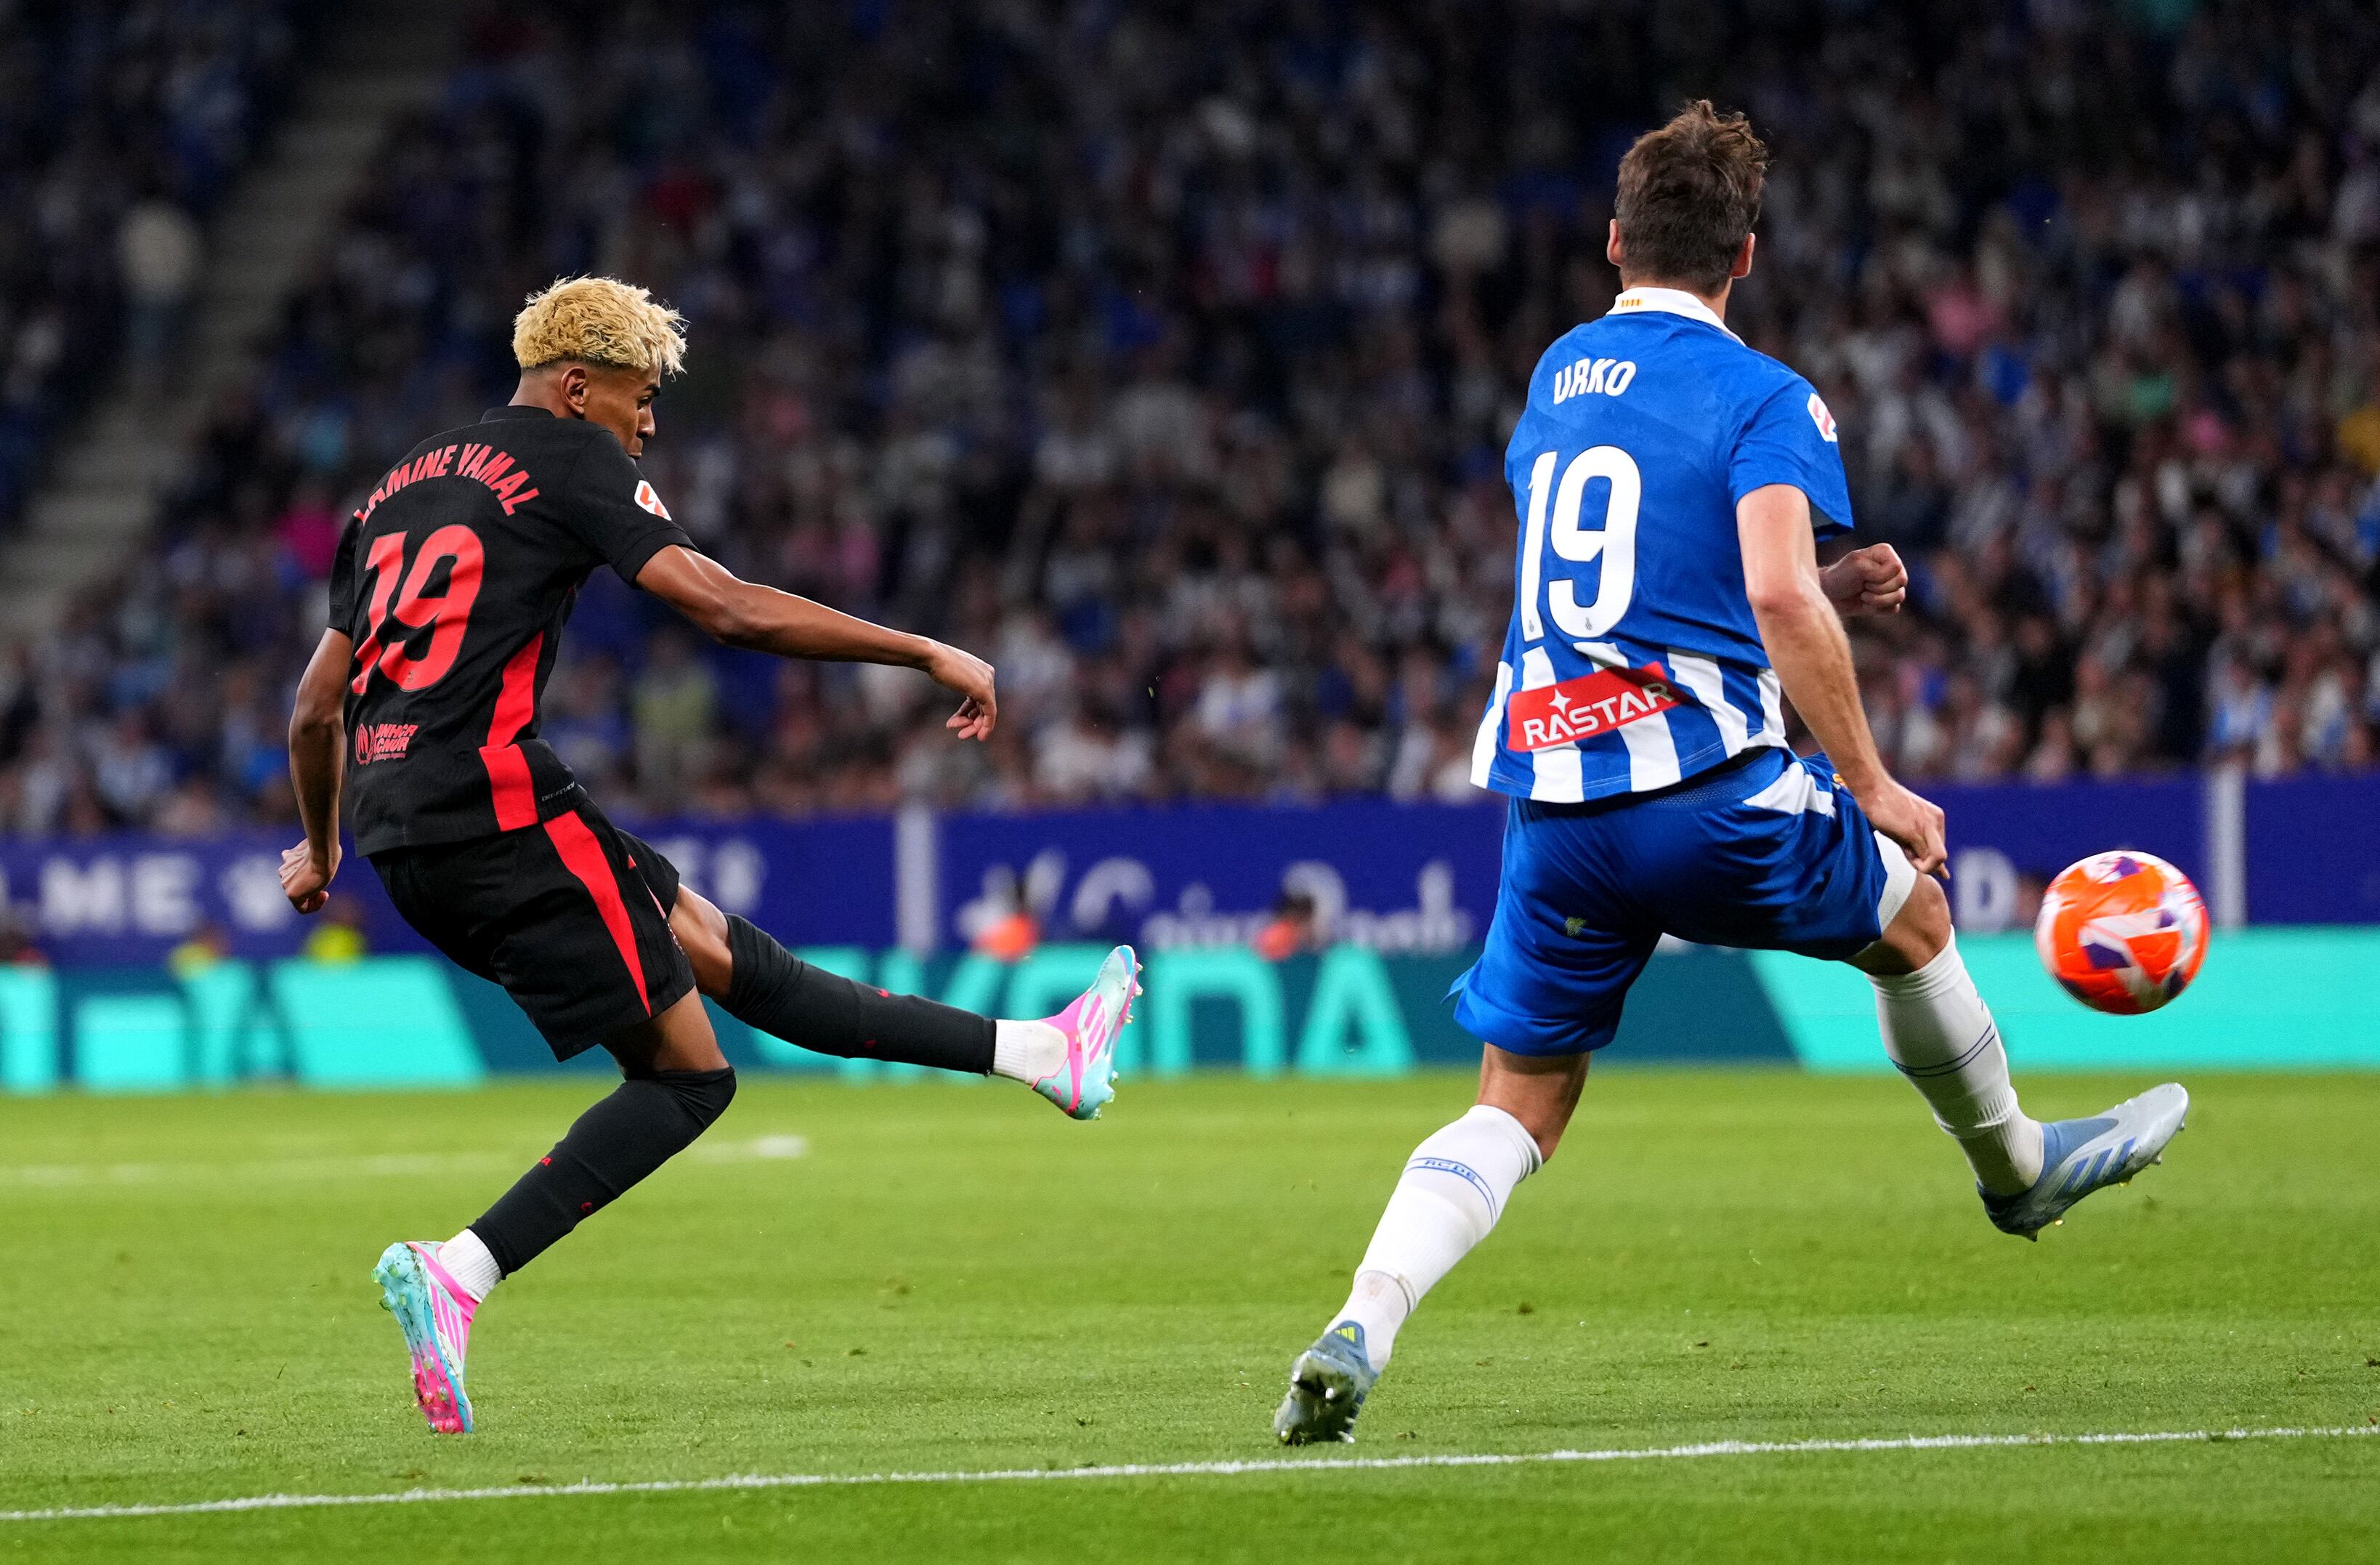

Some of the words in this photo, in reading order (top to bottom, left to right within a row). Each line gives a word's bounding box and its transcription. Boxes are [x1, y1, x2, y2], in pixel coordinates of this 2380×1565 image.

[1553, 358, 1637, 404] URKO
[455, 443, 540, 516] YAMAL
[1521, 445, 1641, 642] 19
[352, 524, 485, 696] 19
[1522, 682, 1675, 746] RASTAR
